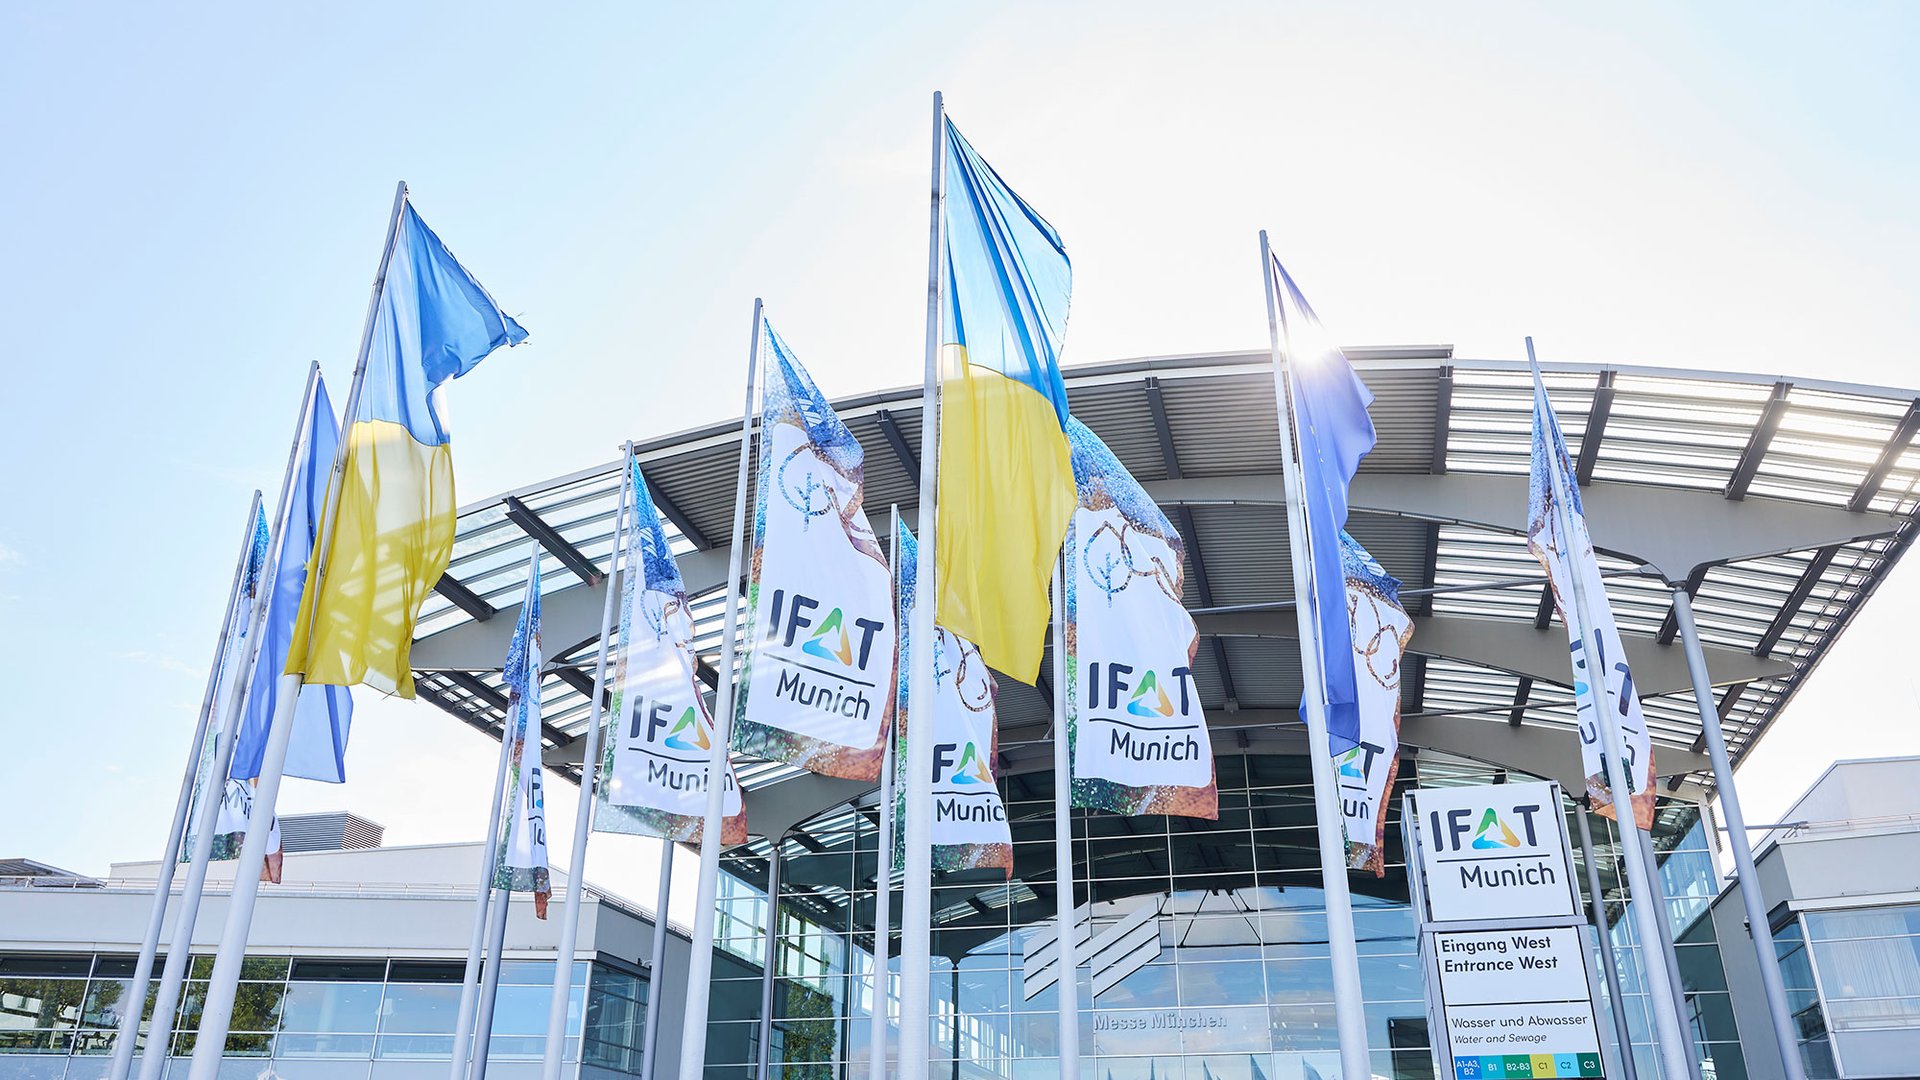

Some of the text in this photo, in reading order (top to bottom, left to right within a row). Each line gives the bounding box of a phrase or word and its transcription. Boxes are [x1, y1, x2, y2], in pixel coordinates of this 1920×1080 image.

[766, 589, 884, 670] IFAT
[775, 668, 871, 721] Munich
[1088, 662, 1192, 718] IFAT
[629, 695, 712, 751] IFA
[1110, 728, 1199, 761] Munich
[936, 798, 1007, 823] Munic
[1430, 804, 1540, 852] IFAT
[1459, 861, 1556, 889] Munich
[1441, 936, 1551, 955] Eingang West
[1444, 956, 1558, 973] Entrance West
[1094, 1012, 1228, 1031] Messe München
[1451, 1015, 1588, 1029] Wasser und Abwasser
[1454, 1033, 1547, 1045] Water and Sewage
[1463, 1067, 1475, 1076] B2
[1487, 1063, 1498, 1071] B1
[1506, 1062, 1531, 1071] B2-B3
[1538, 1062, 1548, 1070] C1
[1560, 1061, 1572, 1070] C2
[1583, 1060, 1596, 1069] C3
